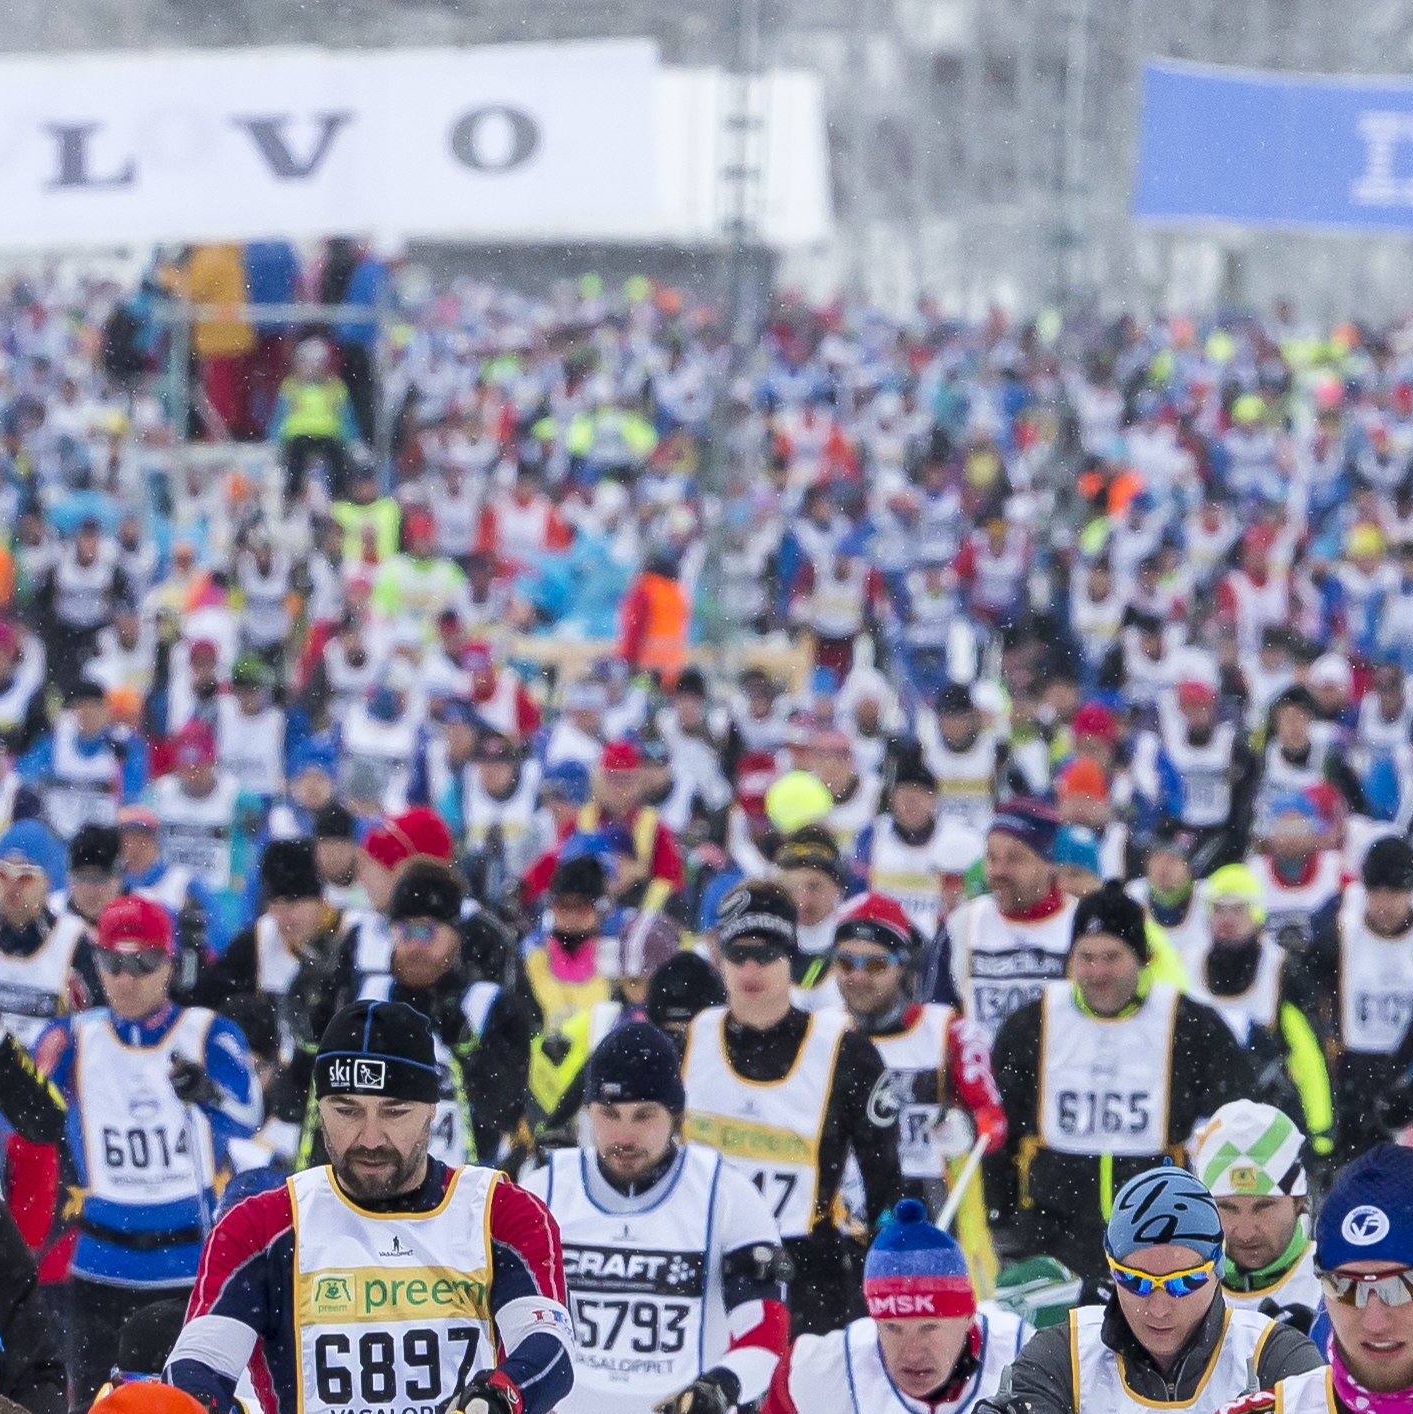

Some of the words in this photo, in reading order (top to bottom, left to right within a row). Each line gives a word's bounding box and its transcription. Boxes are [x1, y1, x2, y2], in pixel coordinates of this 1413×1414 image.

[329, 1059, 350, 1081] ski
[365, 1276, 486, 1314] preem
[577, 1299, 690, 1355] 5793
[314, 1327, 481, 1405] 6897
